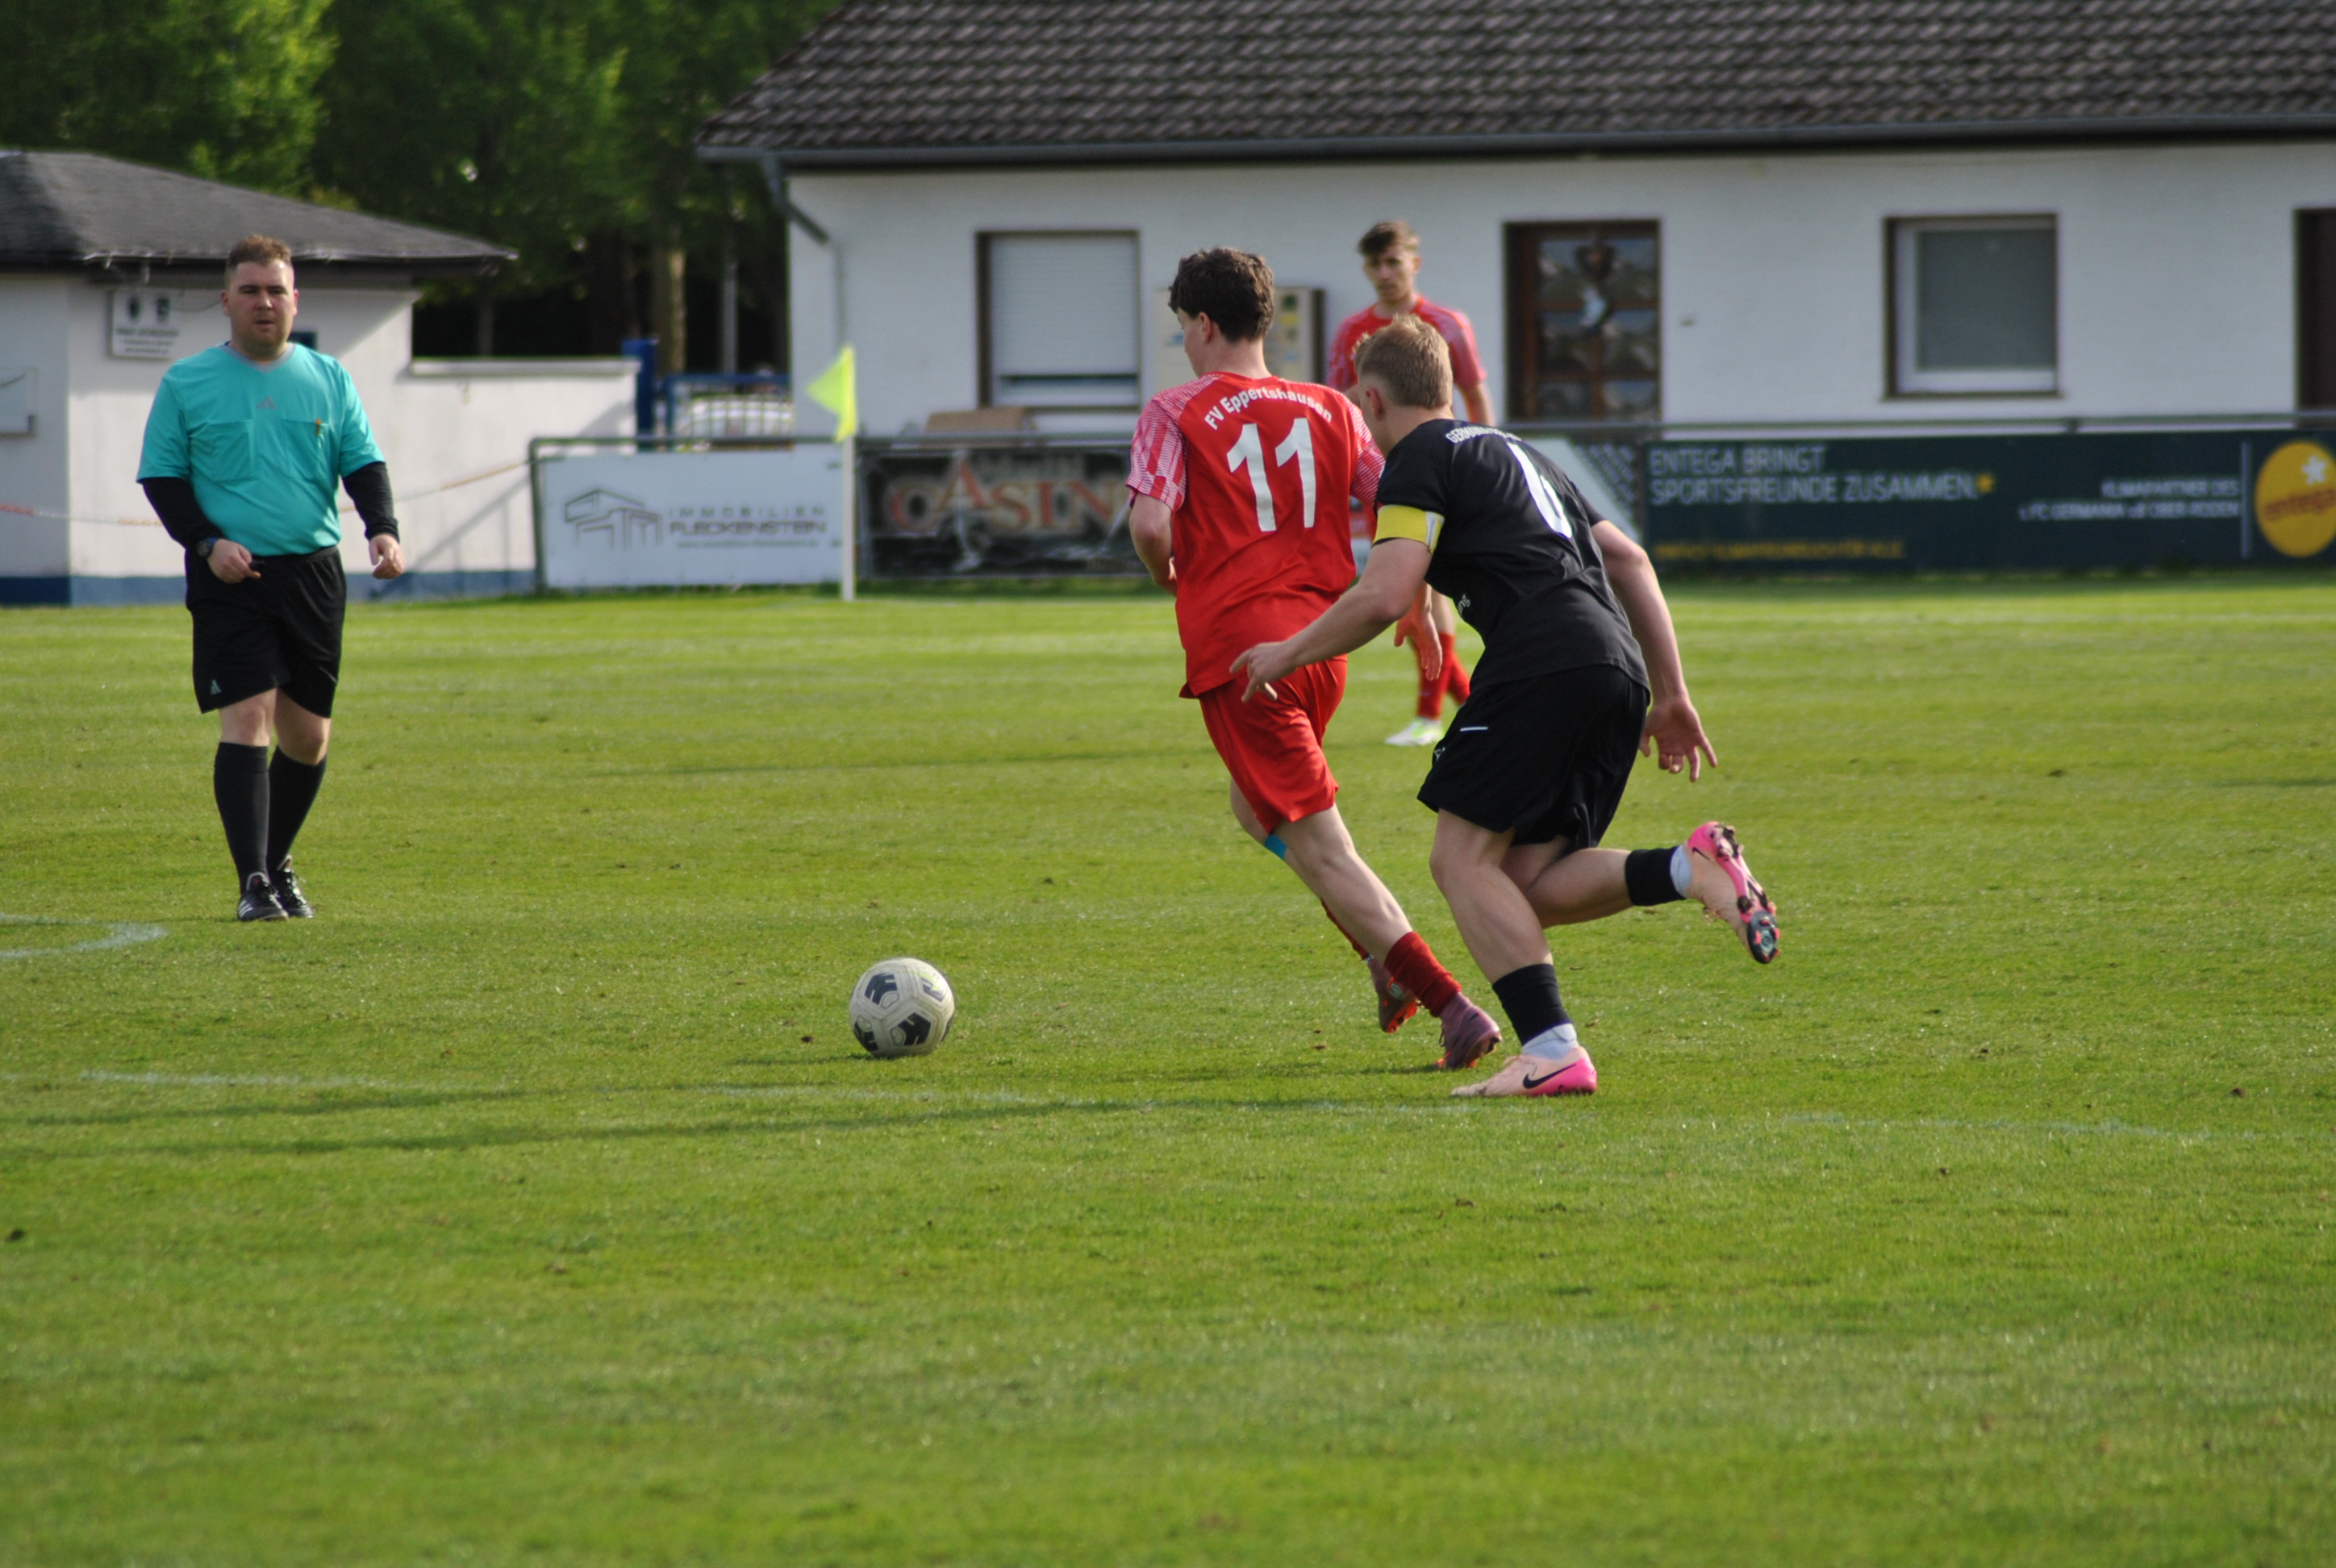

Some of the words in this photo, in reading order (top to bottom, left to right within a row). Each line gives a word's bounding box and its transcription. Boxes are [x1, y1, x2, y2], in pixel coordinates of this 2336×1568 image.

[1204, 406, 1224, 431] FV
[1220, 387, 1332, 423] Eppertshausen
[1651, 448, 1736, 474] ENTEGA
[1743, 445, 1826, 473] BRINGT
[1226, 417, 1316, 532] 11
[1651, 477, 1839, 505] SPORTSFREUNDE
[669, 507, 824, 517] IMMOBILIEN
[670, 521, 826, 535] FLECKENSTEIN
